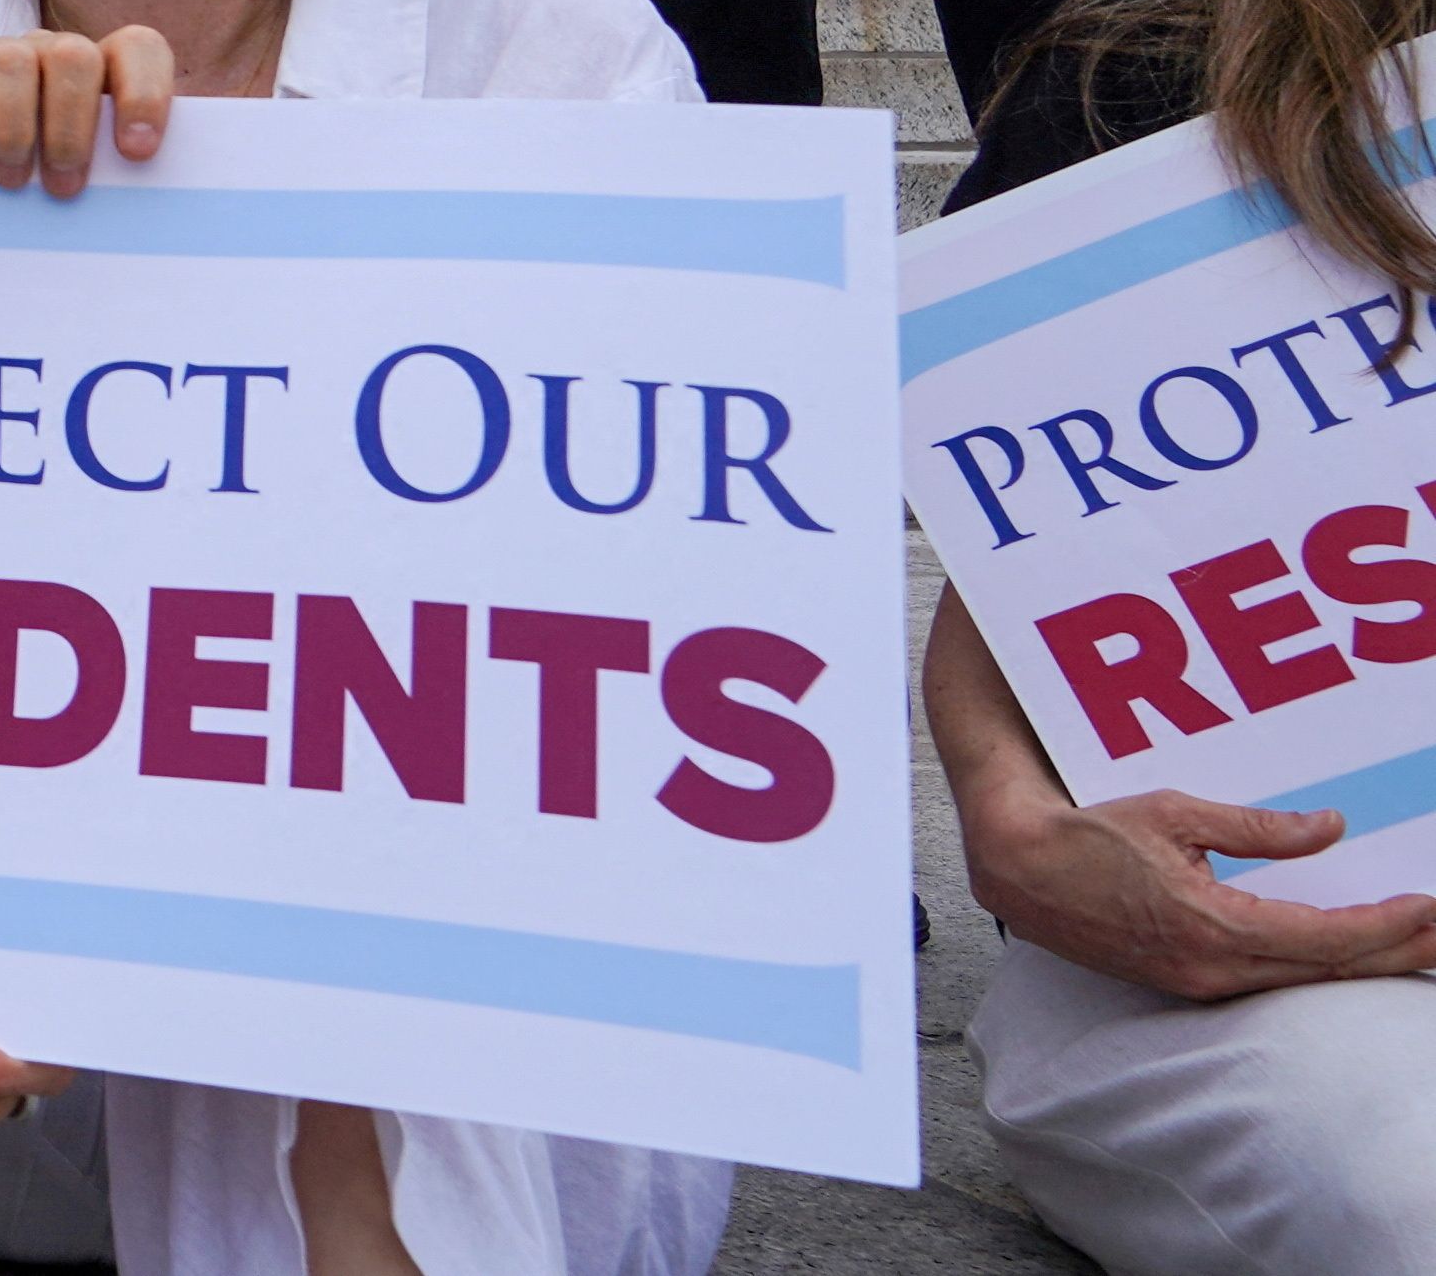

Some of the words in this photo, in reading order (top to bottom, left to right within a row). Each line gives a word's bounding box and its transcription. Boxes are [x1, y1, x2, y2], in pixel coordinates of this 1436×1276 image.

[353, 343, 836, 535] OUR
[931, 293, 1436, 551] PROTE
[1033, 480, 1436, 762] RES
